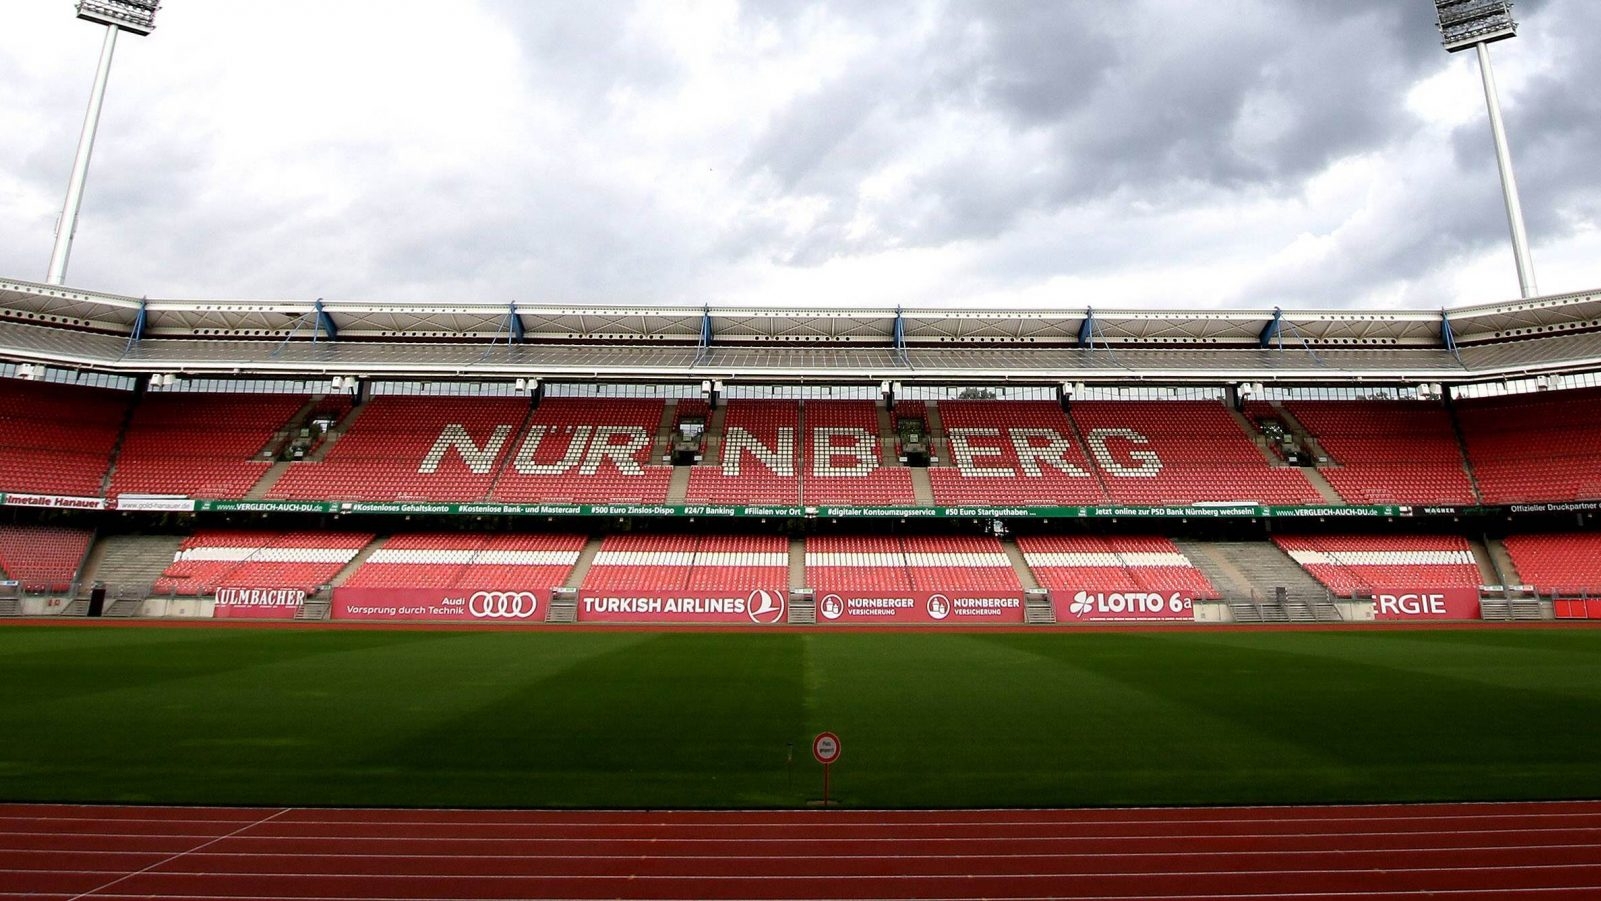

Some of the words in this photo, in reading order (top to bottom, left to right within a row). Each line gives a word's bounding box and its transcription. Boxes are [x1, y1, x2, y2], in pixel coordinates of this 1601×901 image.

[54, 498, 100, 508] Hanauer
[121, 502, 190, 511] www.gold-hanauer.de
[216, 503, 323, 512] www.VERGLEICH-AUCH-DU.de
[353, 503, 400, 512] #Kostenloses
[401, 504, 449, 513] Gehaltskonto
[458, 505, 501, 513] #Kostenlose
[503, 506, 524, 514] Bank-
[525, 506, 540, 514] und
[541, 506, 581, 514] Mastercard
[627, 507, 675, 516] Zinslos-Dispo
[705, 508, 735, 517] Banking
[1095, 508, 1112, 516] Jetzt
[1151, 508, 1165, 516] PSD
[1166, 508, 1183, 516] Bank
[1185, 507, 1219, 517] Nürnberg
[1220, 508, 1255, 516] wechseln!
[1276, 508, 1378, 517] www.VERGLEICH-AUCH-DU.de
[1510, 505, 1546, 513] Offizieller
[1547, 503, 1597, 511] Druckpartner
[827, 509, 861, 517] #digitaler
[863, 509, 936, 517] Kontoumzugsservice
[977, 509, 1028, 517] Startguthaben
[441, 597, 465, 606] Audi
[583, 598, 660, 612] TURKISH
[664, 598, 745, 613] AIRLINES
[848, 597, 914, 607] NÜRNBERGER
[953, 597, 1020, 607] NÜRNBERGER
[1097, 592, 1164, 613] LOTTO
[347, 605, 396, 615] Vorsprung
[398, 606, 426, 614] durch
[428, 606, 464, 614] Technik
